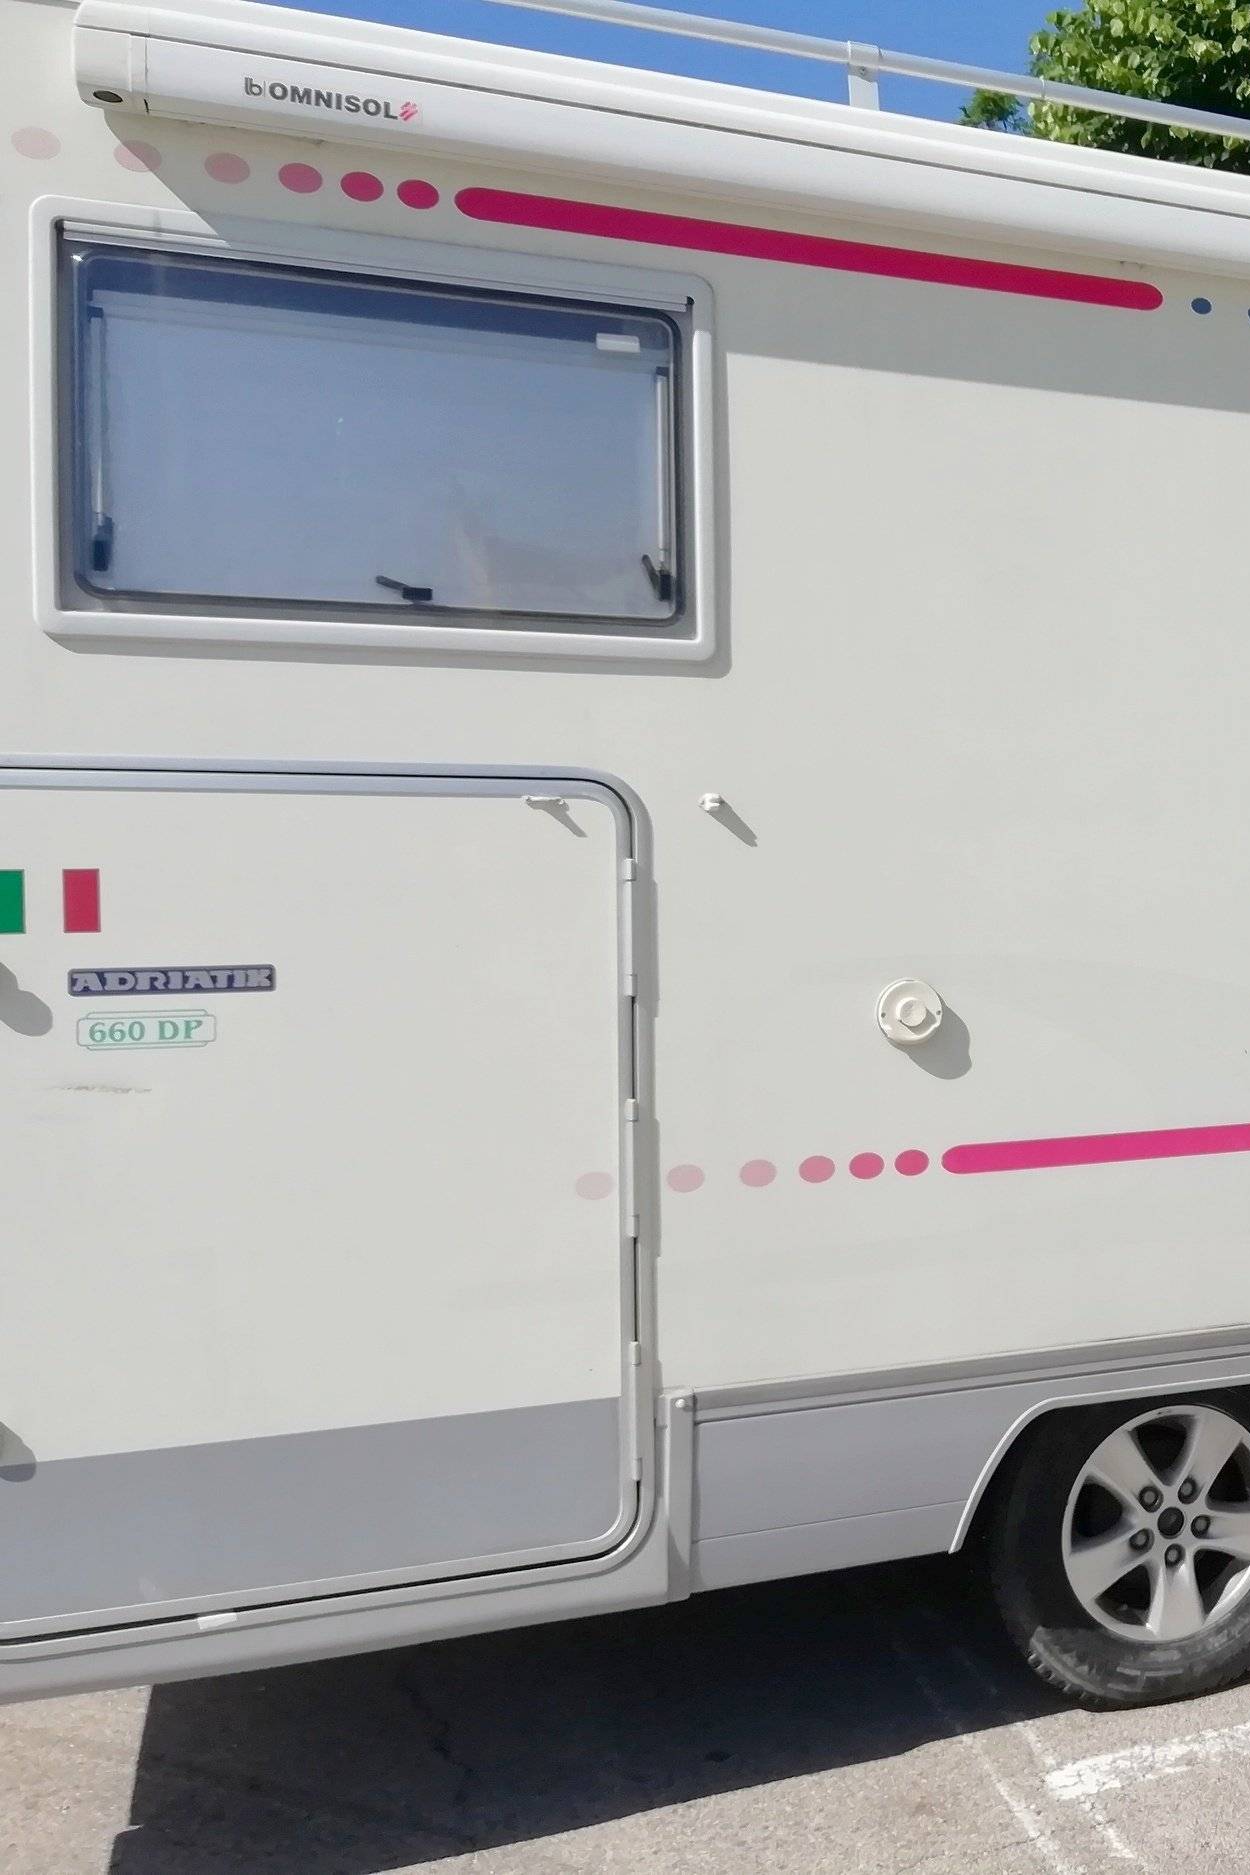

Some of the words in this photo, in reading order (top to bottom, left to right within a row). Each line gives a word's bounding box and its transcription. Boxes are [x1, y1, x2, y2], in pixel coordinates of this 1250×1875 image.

[268, 82, 398, 120] OMNISOL
[73, 969, 271, 991] ADRIATIK
[89, 1021, 146, 1043] 660
[158, 1019, 203, 1041] DP
